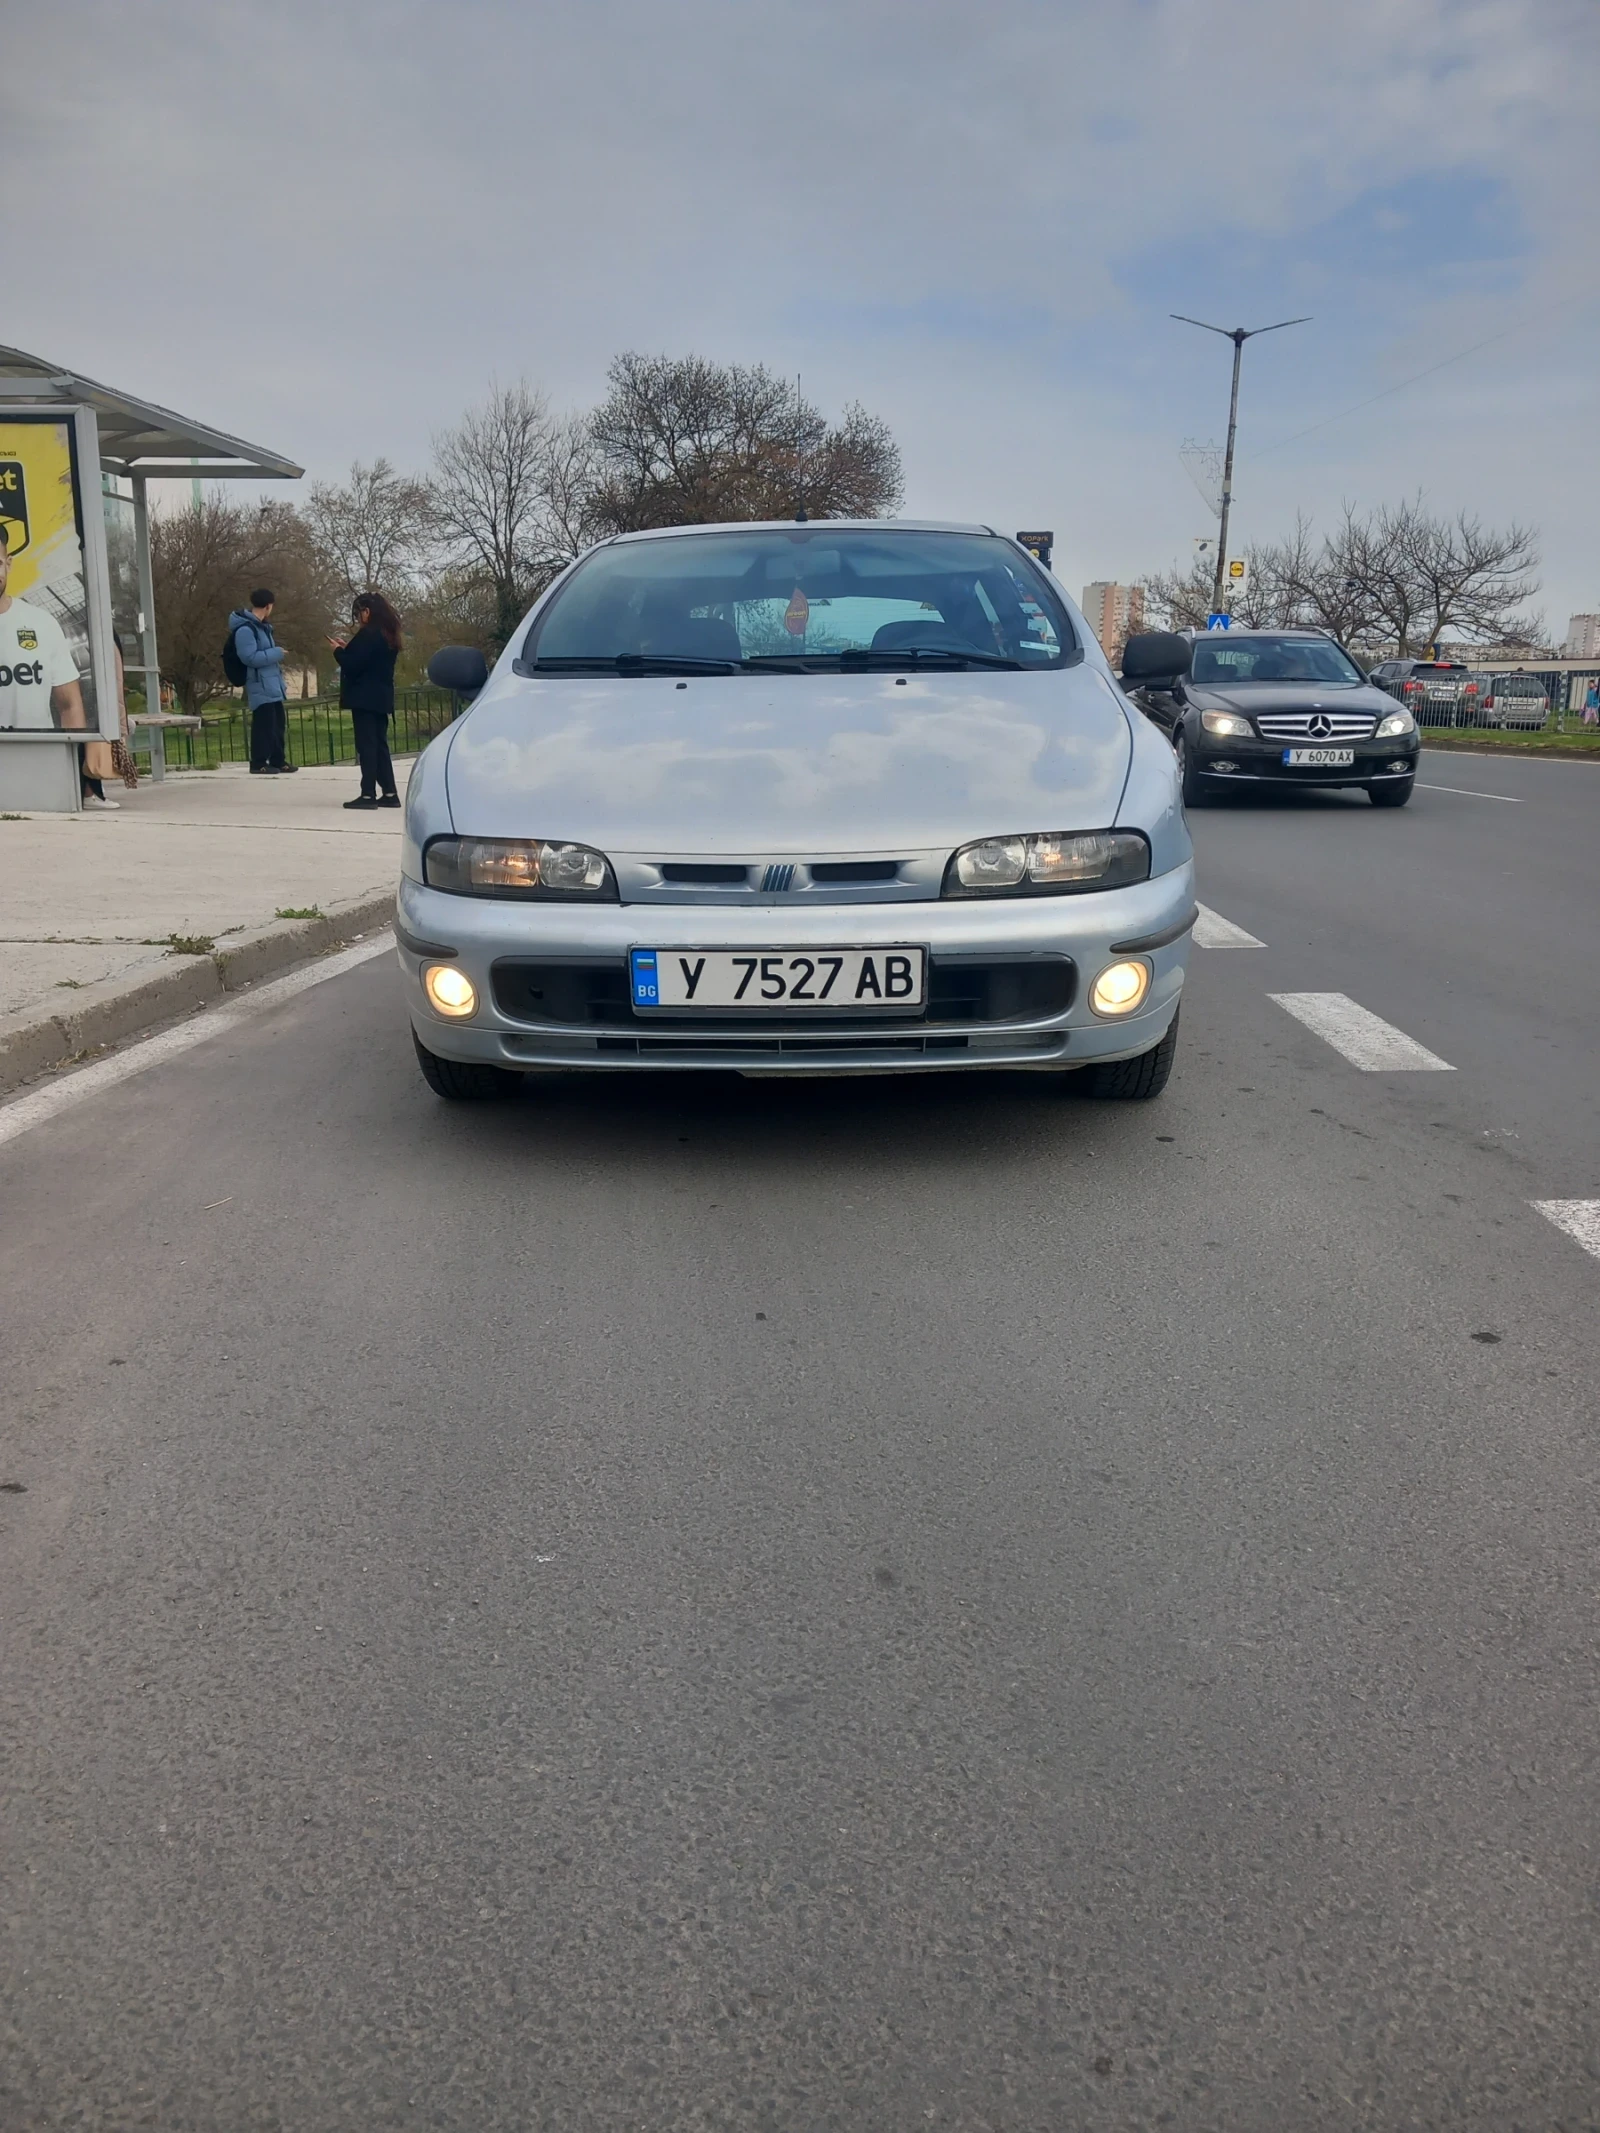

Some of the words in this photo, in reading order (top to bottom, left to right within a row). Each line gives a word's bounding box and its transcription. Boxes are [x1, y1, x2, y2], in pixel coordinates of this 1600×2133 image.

[1308, 751, 1336, 762] 6070
[732, 957, 843, 999] 7527
[855, 956, 913, 998] AB
[638, 985, 656, 997] BG
